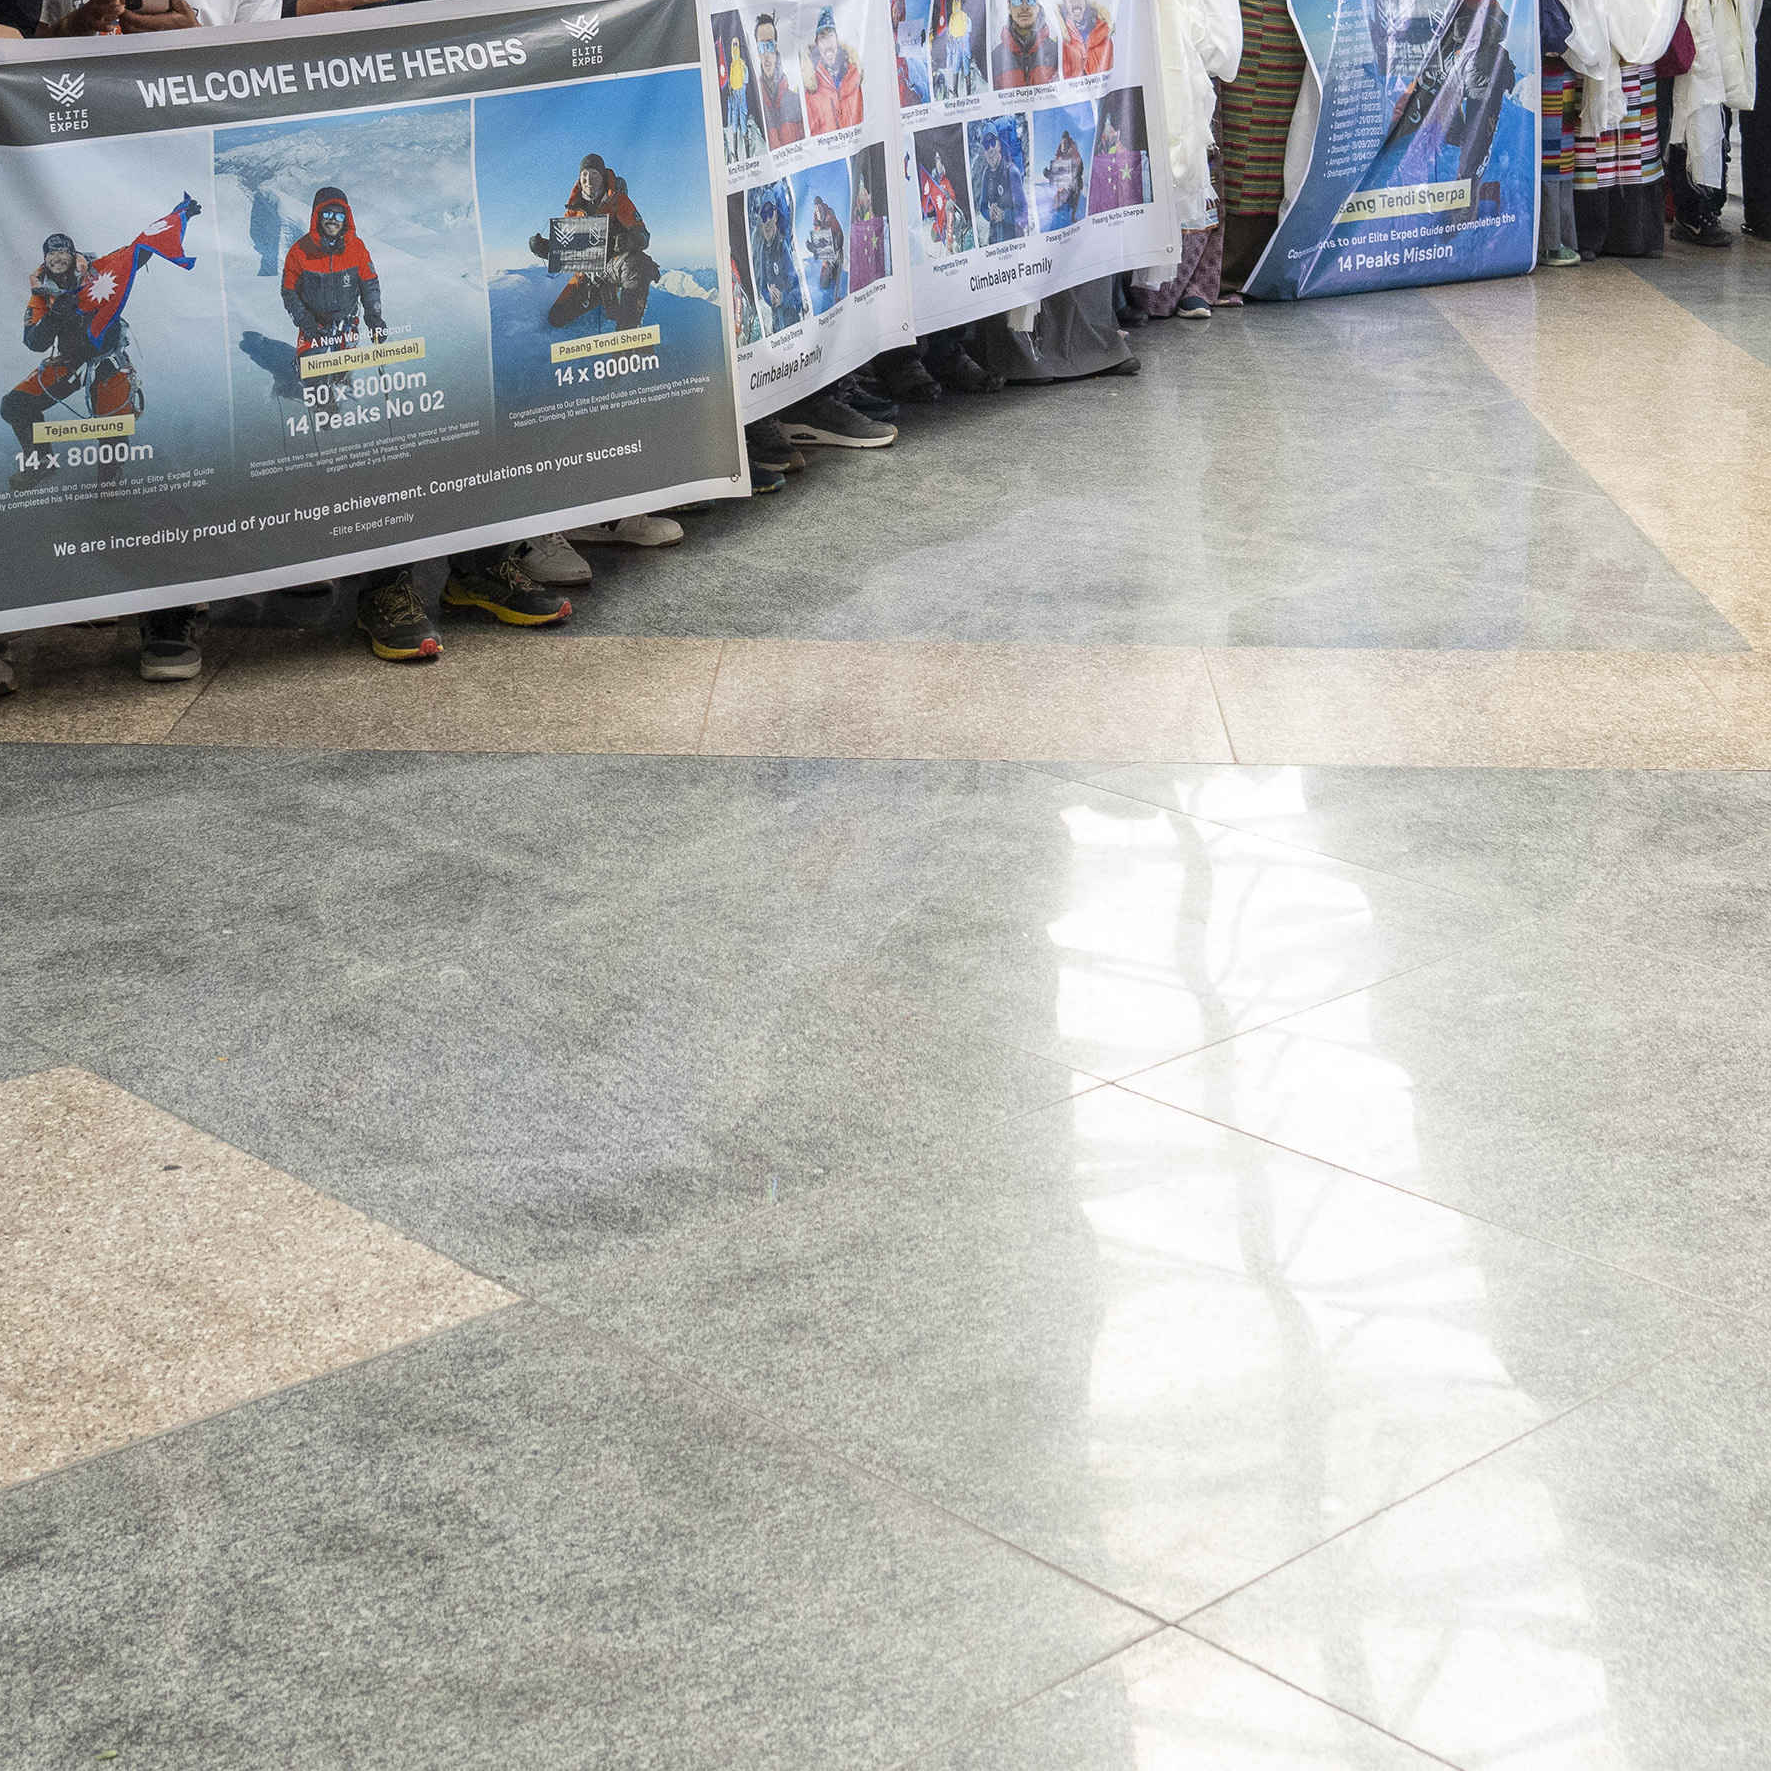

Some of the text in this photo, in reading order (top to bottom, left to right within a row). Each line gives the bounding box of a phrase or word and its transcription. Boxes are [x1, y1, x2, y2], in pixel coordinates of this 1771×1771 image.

[572, 45, 603, 57] ELITE
[572, 55, 603, 68] EXPED
[137, 38, 527, 108] WELCOME HOME HEROES
[48, 109, 88, 122] ELITE
[50, 119, 89, 133] EXPED
[1379, 187, 1465, 207] Tendi Sherpa
[1338, 213, 1515, 247] to our Elite Exped Guide on completing the
[1338, 245, 1453, 272] 14 Peaks Mission
[970, 258, 1053, 292] Climbalaya Family
[310, 322, 412, 349] A New World Record
[559, 332, 652, 356] Pasang Tendi Sherpa
[308, 357, 342, 371] Nirmal
[344, 351, 370, 365] Purja
[555, 354, 660, 387] 14 x 8000m
[750, 345, 823, 390] Climbalaya Family
[303, 371, 427, 408] 50 x 8000m
[286, 390, 445, 437] 14 Peaks No 02
[45, 420, 124, 437] Tejan Gurung
[15, 442, 154, 472] 14 x 8000m
[13, 485, 59, 499] Commando
[62, 482, 78, 492] and
[80, 481, 98, 490] now
[101, 479, 116, 488] one
[131, 476, 144, 485] our
[147, 473, 164, 483] Elite
[193, 466, 215, 477] Guide
[53, 439, 643, 558] We are incredibly proud of your huge achievement. Congratulations on your success!
[355, 518, 383, 534] Exped
[385, 512, 415, 529] Family
